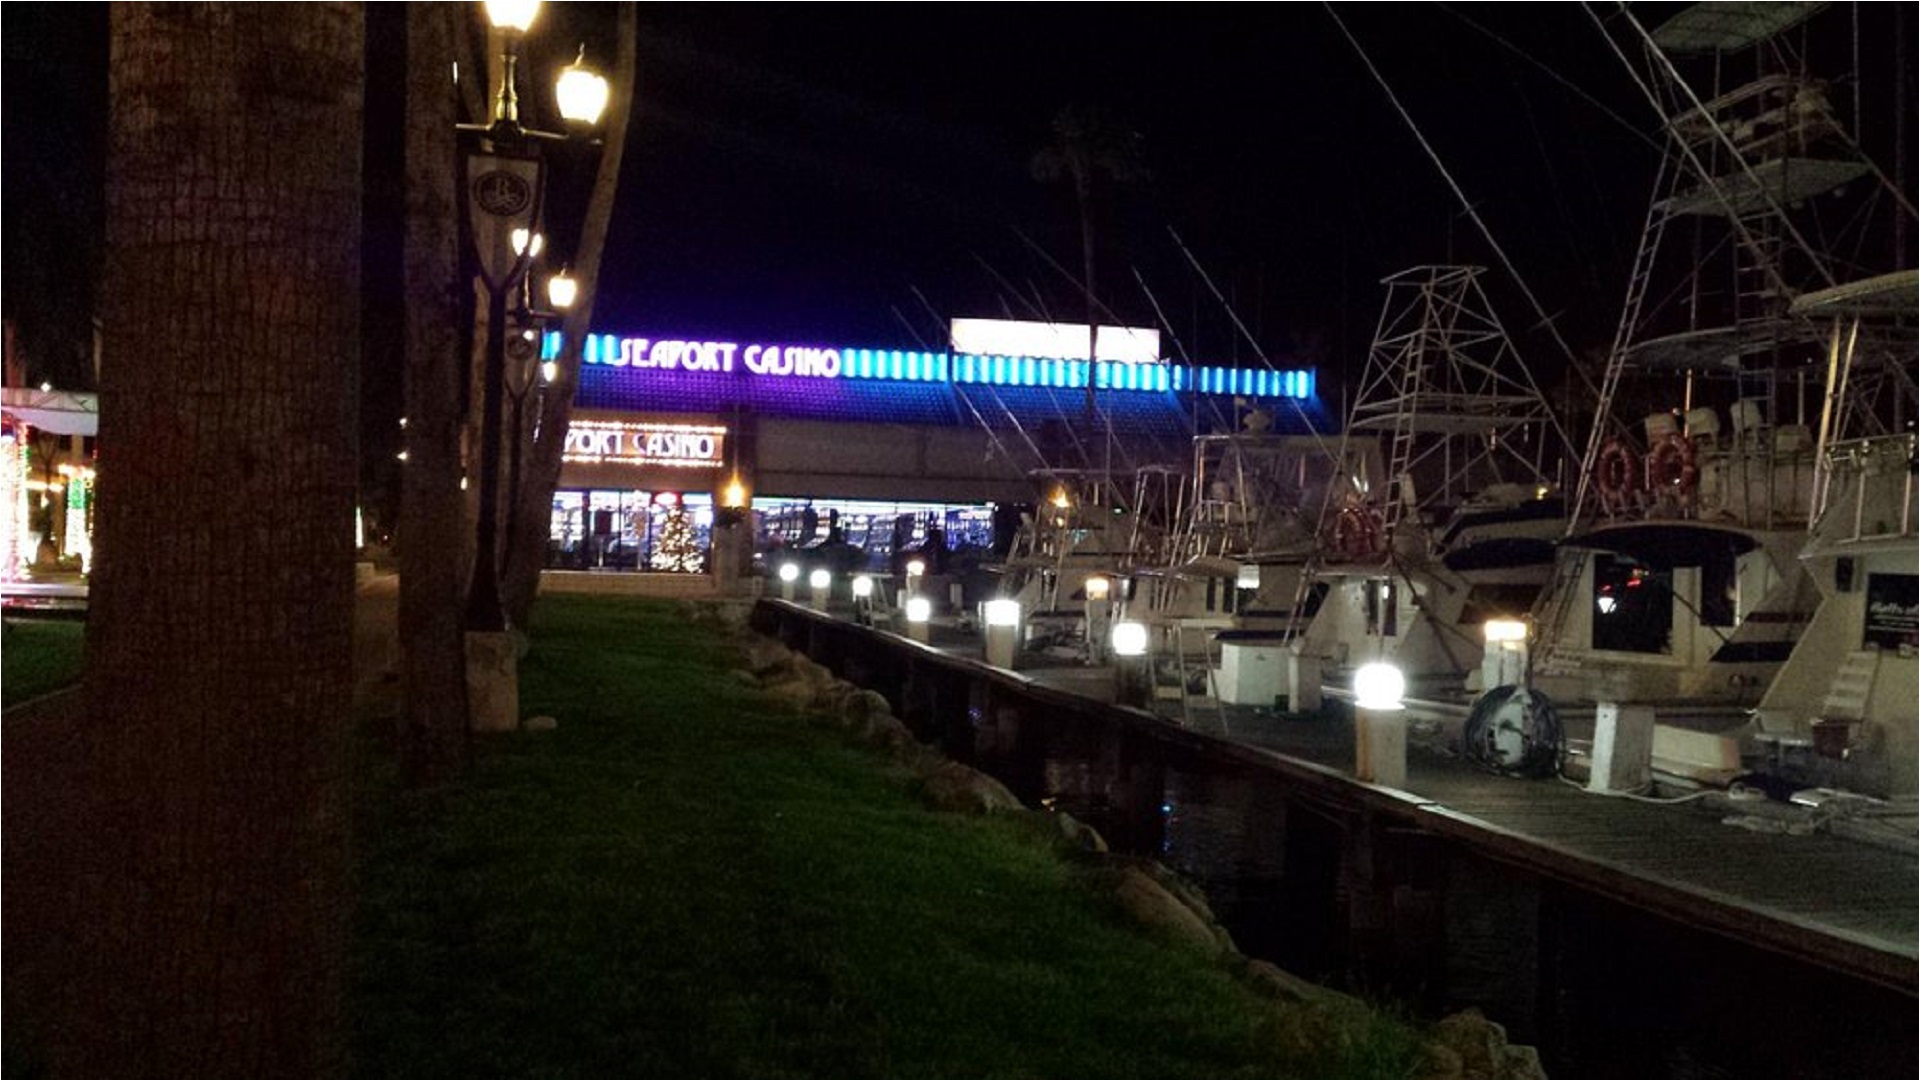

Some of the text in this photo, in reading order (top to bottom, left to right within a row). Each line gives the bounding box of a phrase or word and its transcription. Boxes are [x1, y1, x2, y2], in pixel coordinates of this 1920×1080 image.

[615, 338, 842, 378] SEAPORT CASINO
[632, 433, 715, 459] CASINO
